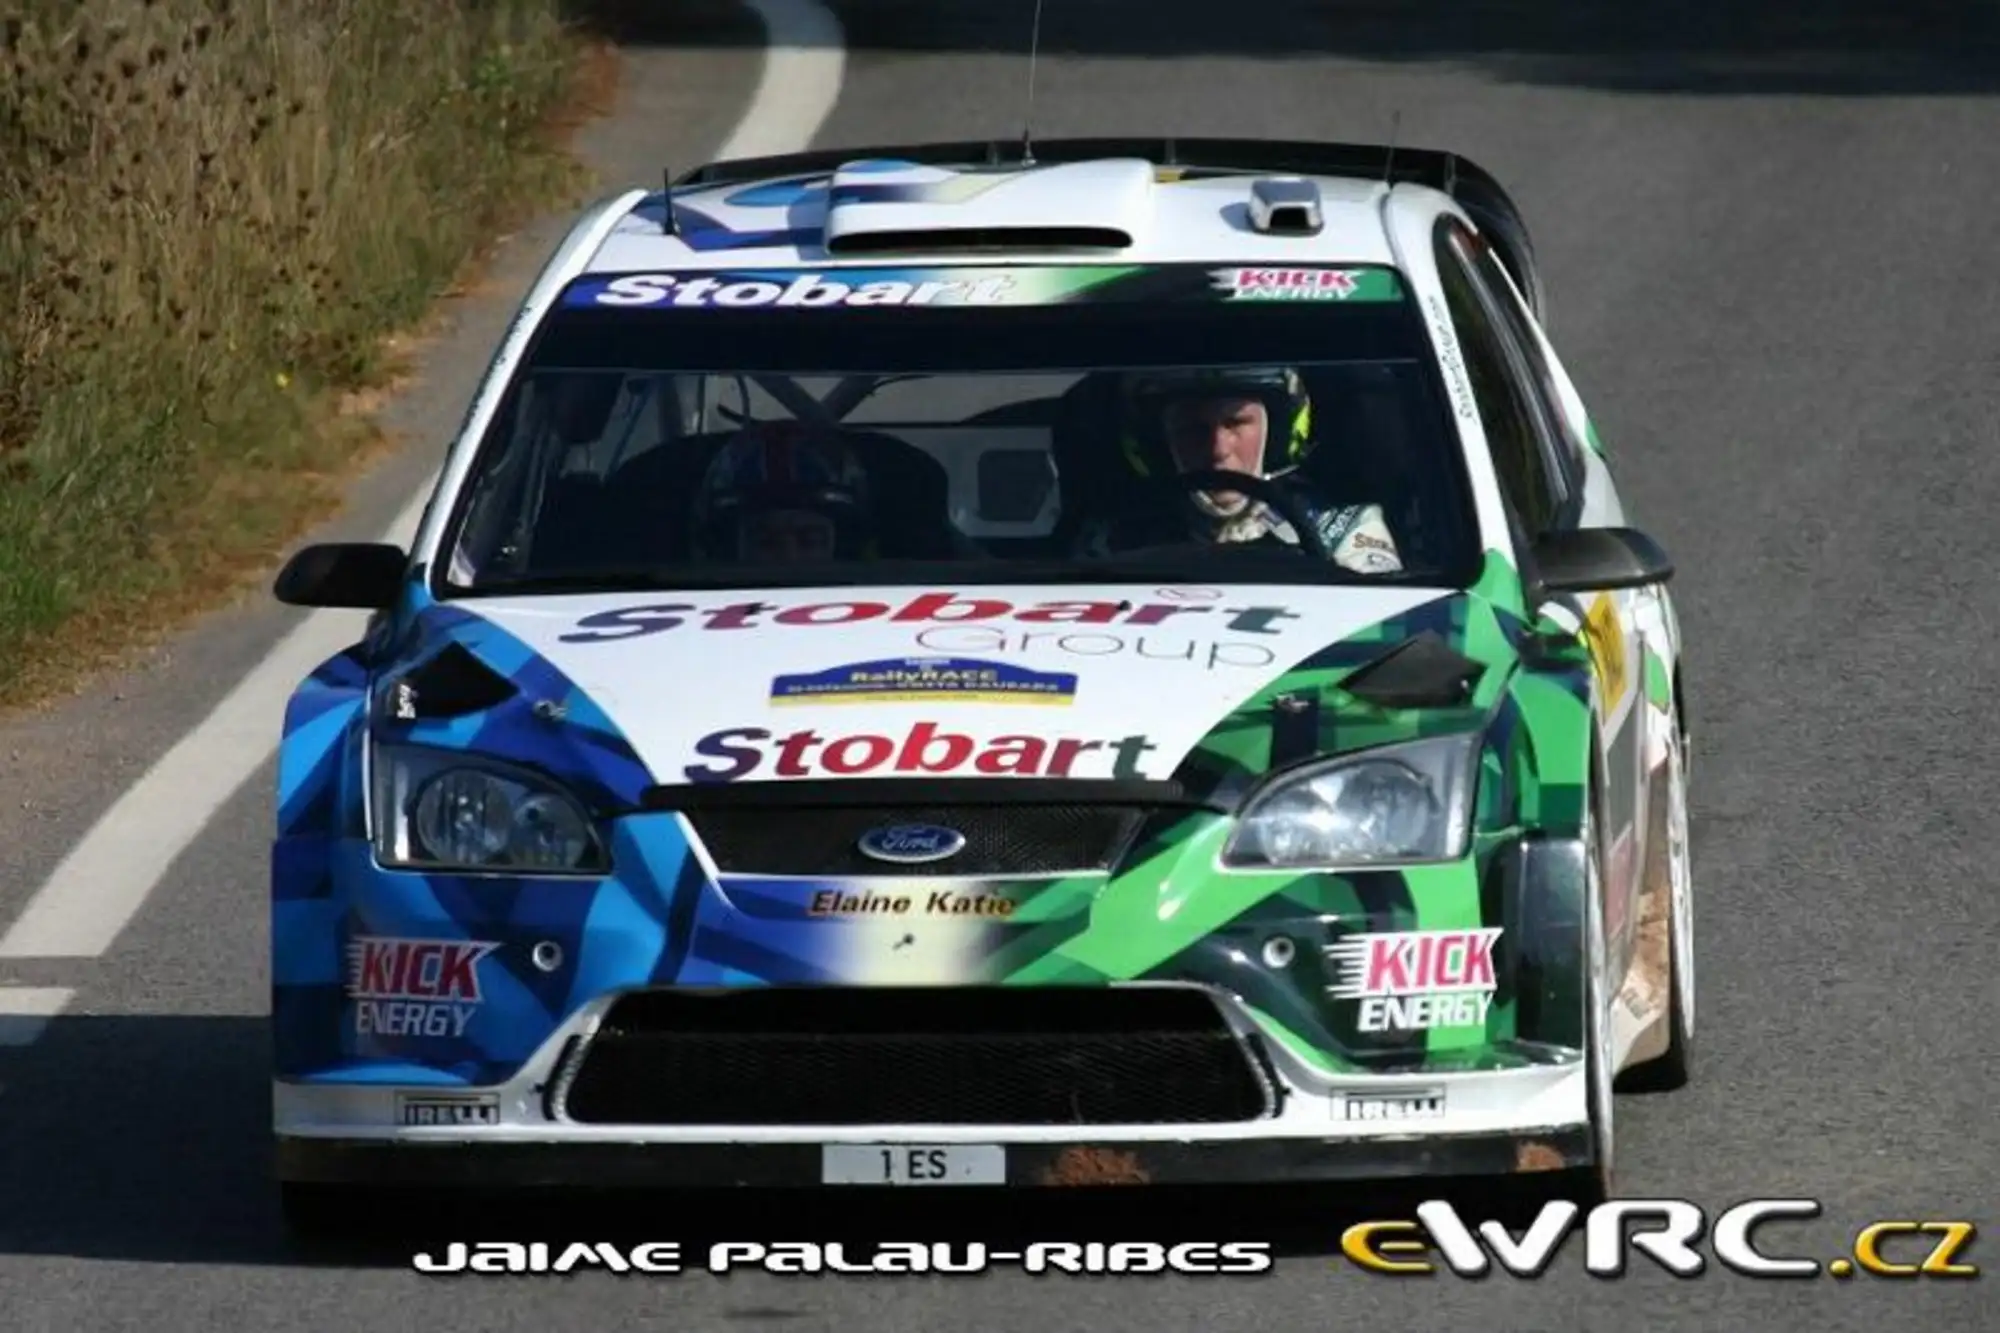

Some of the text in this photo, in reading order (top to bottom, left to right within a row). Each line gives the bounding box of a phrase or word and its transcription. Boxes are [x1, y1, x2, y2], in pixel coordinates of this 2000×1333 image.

[595, 273, 1015, 306] Stobart
[1238, 268, 1357, 288] KICK
[558, 591, 1300, 643] Stobart
[915, 624, 1275, 669] Group
[684, 722, 1157, 783] Stobart
[881, 825, 938, 851] Ford
[810, 889, 1016, 915] Elaine Katie
[360, 941, 486, 998] KICK
[1366, 934, 1495, 992] KICK
[356, 1001, 476, 1037] ENERGY
[1357, 991, 1493, 1032] ENERGY
[907, 1149, 948, 1179] ES
